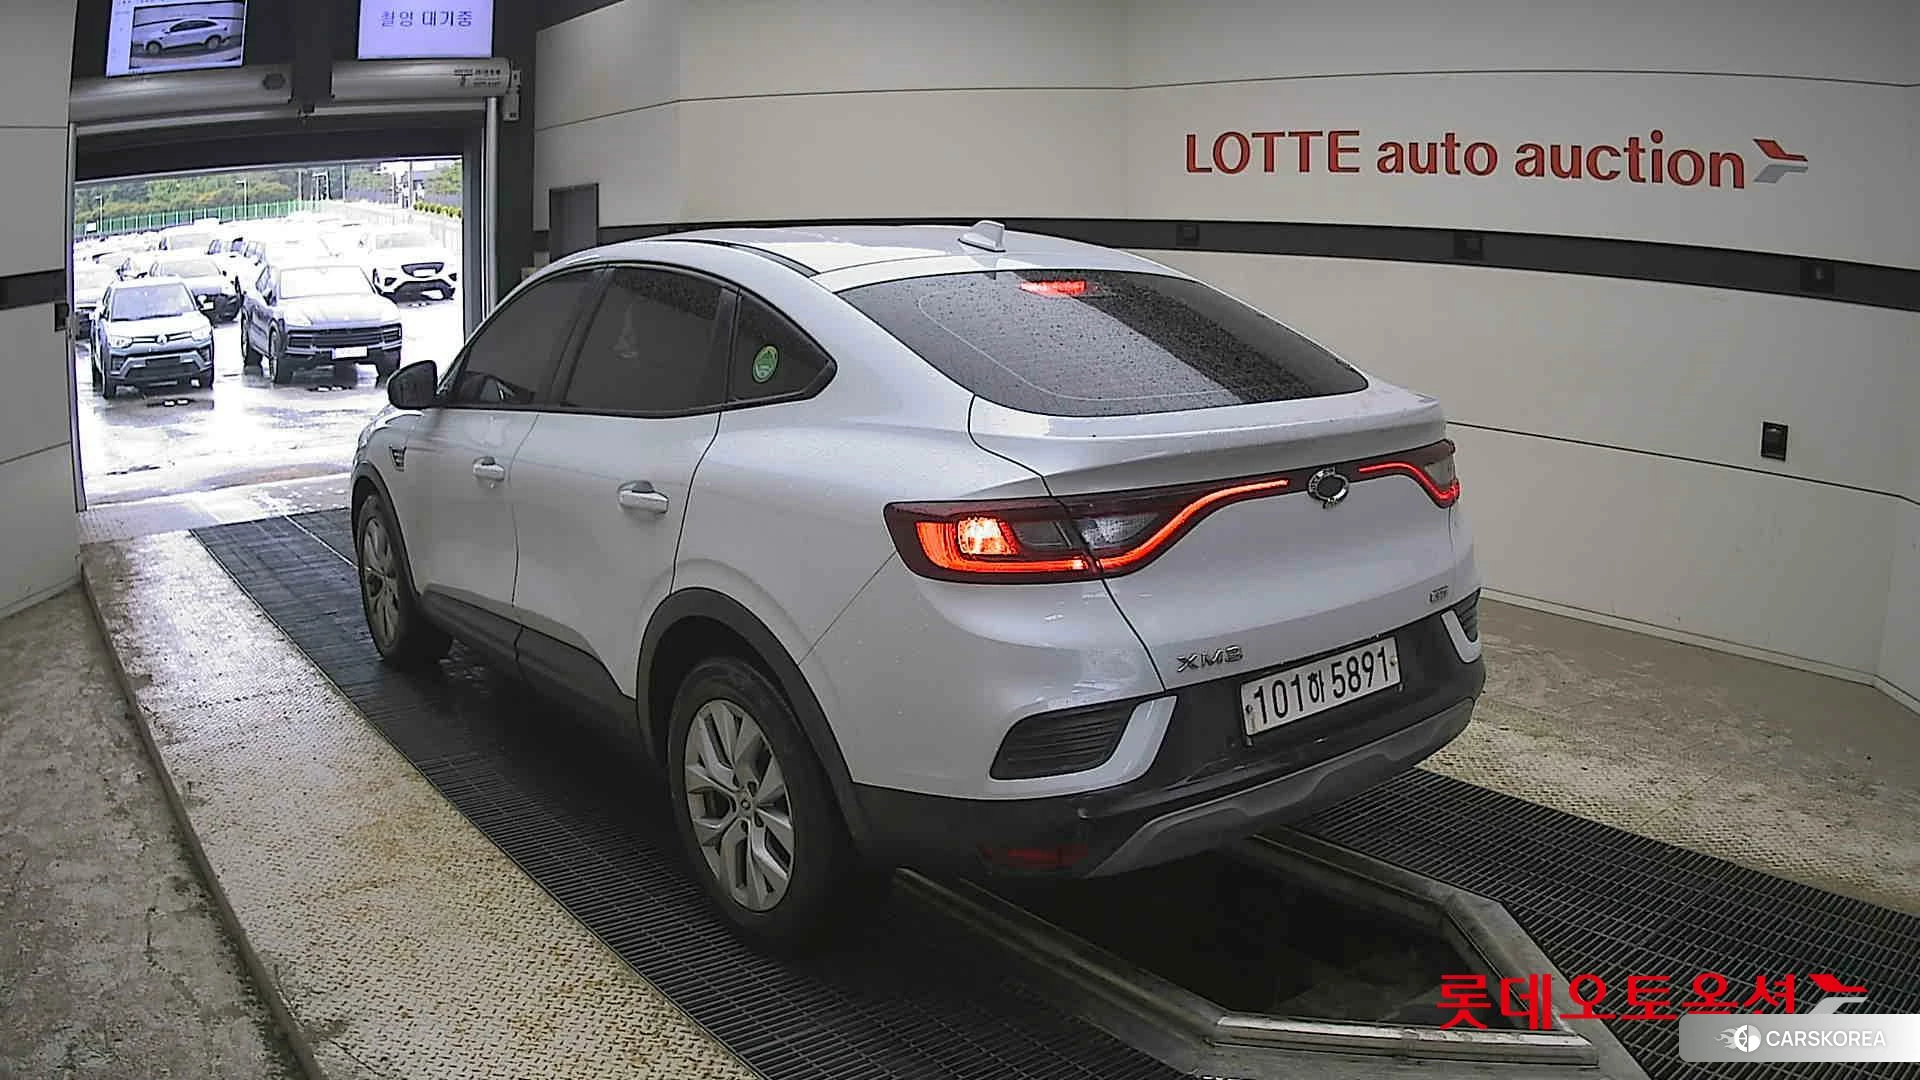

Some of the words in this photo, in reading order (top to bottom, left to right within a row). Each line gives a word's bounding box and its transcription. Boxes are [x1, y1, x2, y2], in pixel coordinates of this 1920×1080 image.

[422, 10, 473, 27] 대기중
[1186, 130, 1361, 175] LOTTE
[1378, 134, 1498, 176] auto
[1516, 130, 1745, 189] auction
[1253, 669, 1325, 724] 101하
[1331, 645, 1388, 699] 5891
